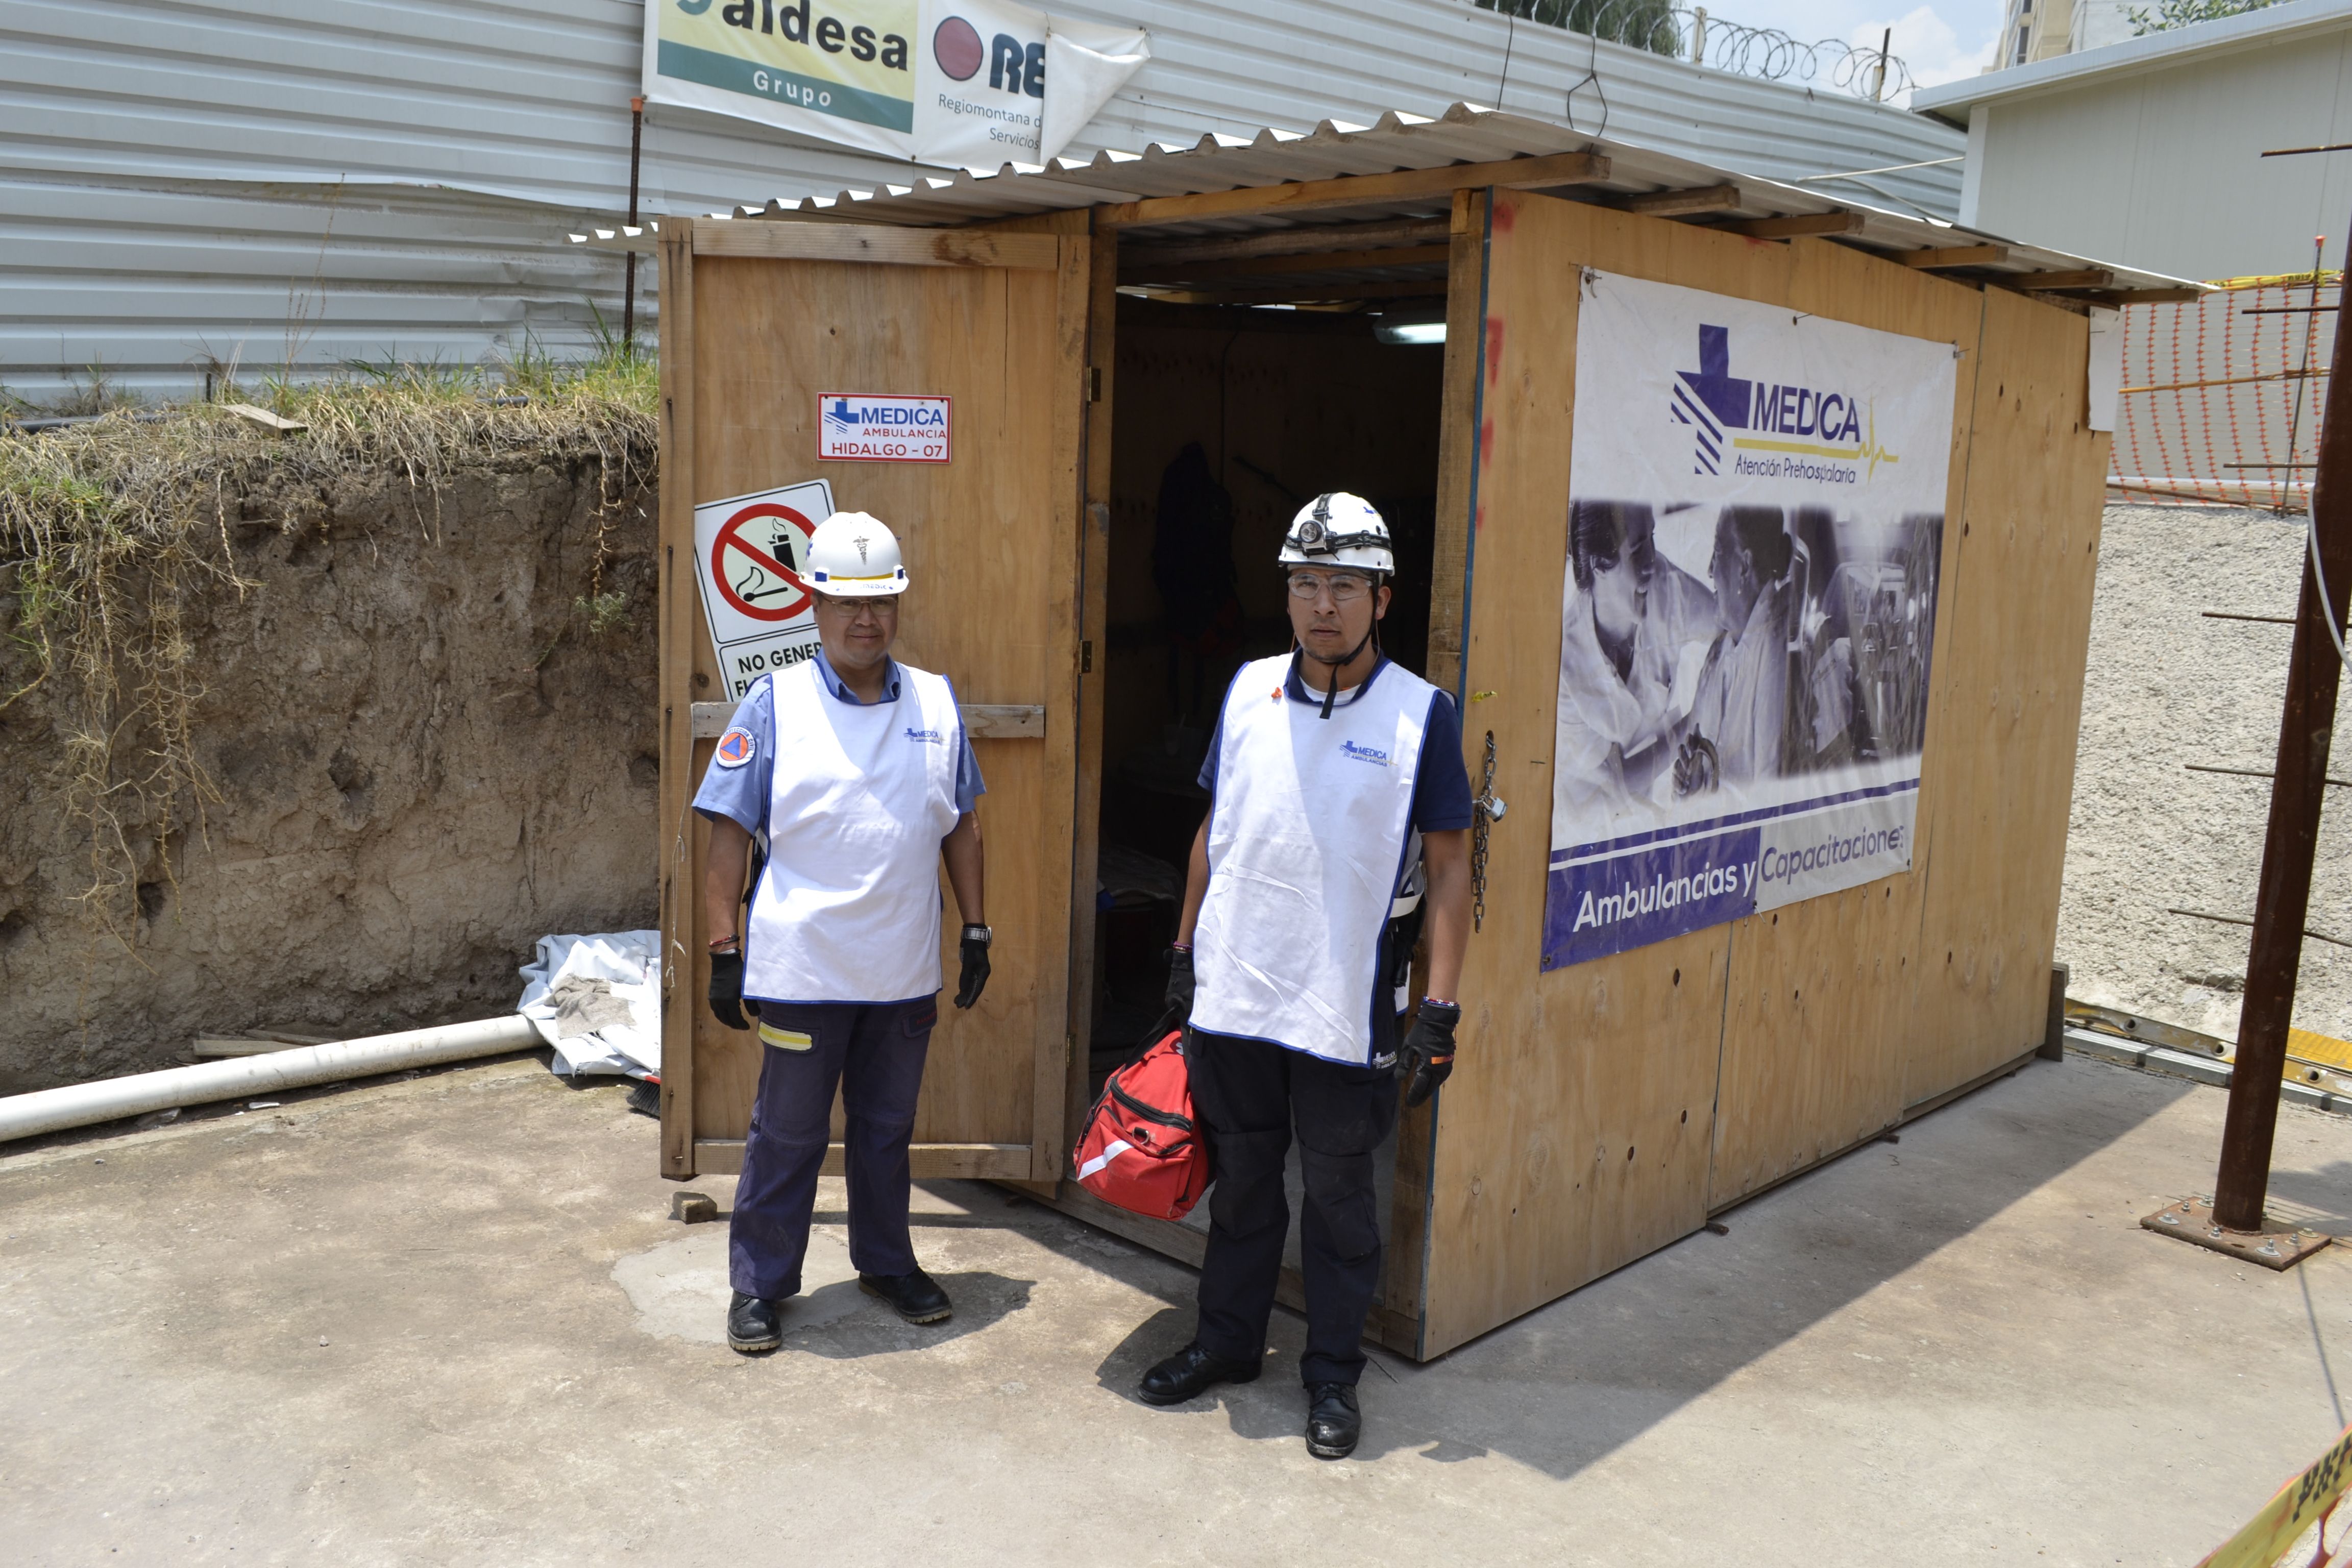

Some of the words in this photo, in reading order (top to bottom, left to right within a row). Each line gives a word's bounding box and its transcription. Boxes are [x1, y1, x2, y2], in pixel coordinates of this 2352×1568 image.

[753, 70, 831, 106] Grupo
[939, 93, 1030, 126] Regiomontana
[862, 407, 944, 426] MEDICA
[1753, 382, 1860, 443] MEDICA
[863, 428, 946, 438] AMBULANCIA
[832, 443, 906, 456] HIDALGO
[923, 445, 943, 457] 07
[1735, 453, 1781, 478] Atención
[738, 654, 765, 674] NO
[917, 730, 939, 739] MEDICA
[1351, 755, 1388, 767] AMBULANCIAS
[1358, 746, 1387, 761] MEDICA
[1573, 863, 1737, 932] Ambulancias
[1743, 861, 1757, 897] y
